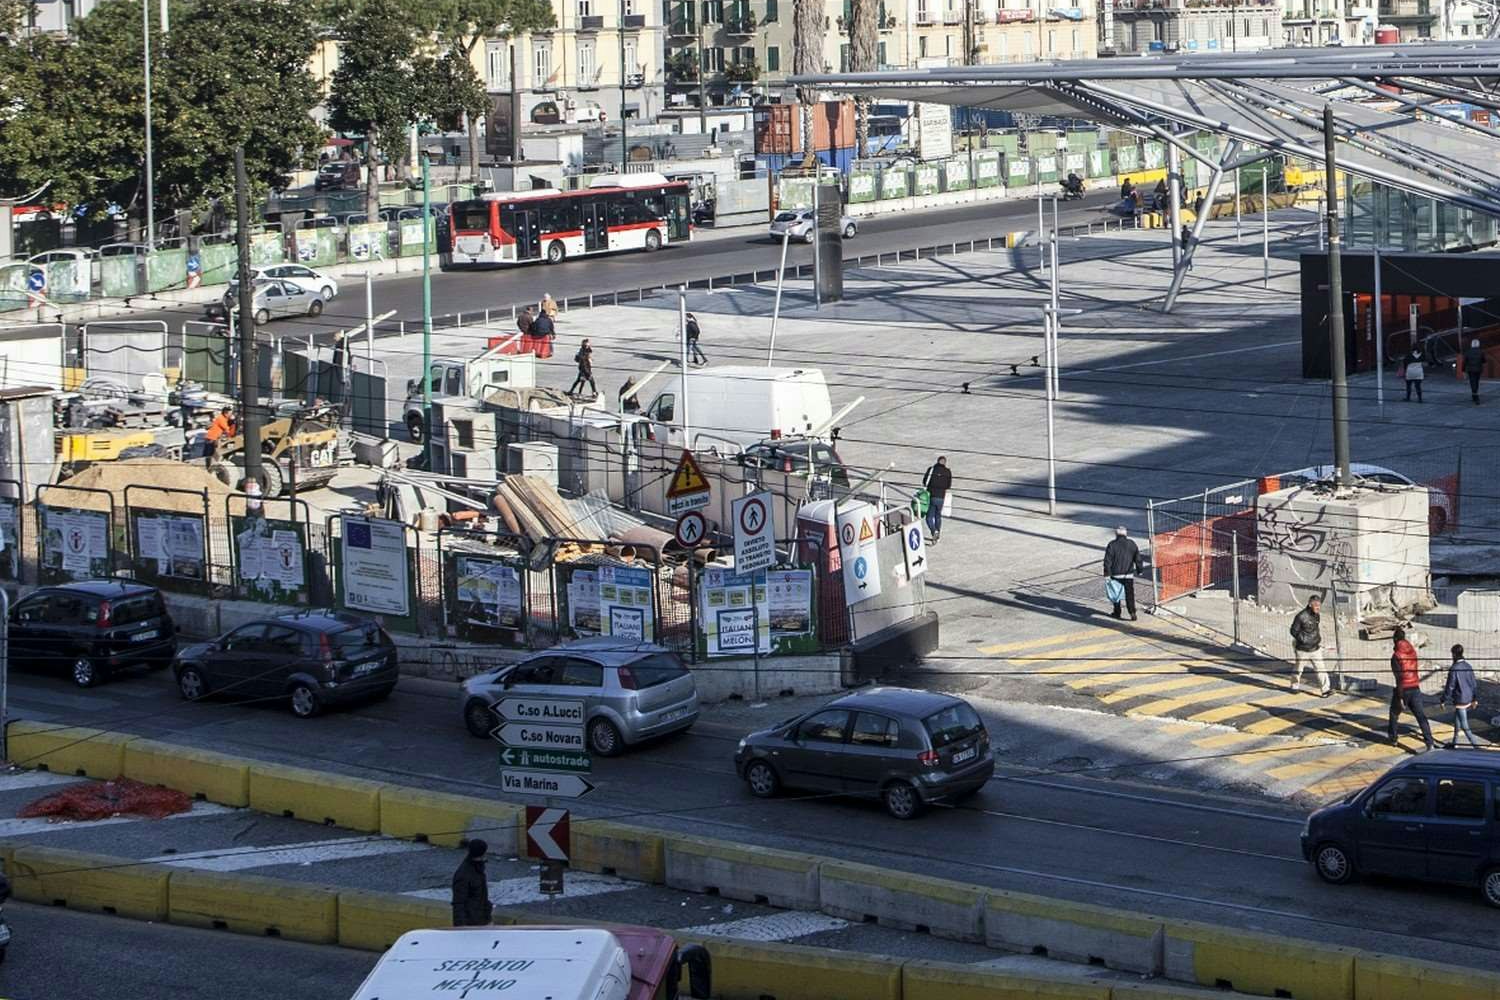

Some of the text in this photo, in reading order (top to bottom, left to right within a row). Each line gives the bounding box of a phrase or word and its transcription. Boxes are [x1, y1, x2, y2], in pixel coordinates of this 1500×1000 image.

[311, 450, 334, 466] CAT
[517, 703, 582, 720] C.so A.Lucci
[520, 728, 582, 745] C.so Novara
[533, 755, 590, 768] autostrade
[504, 775, 559, 792] Via Marina
[433, 958, 535, 972] SERBATOI
[432, 979, 517, 991] METANO
